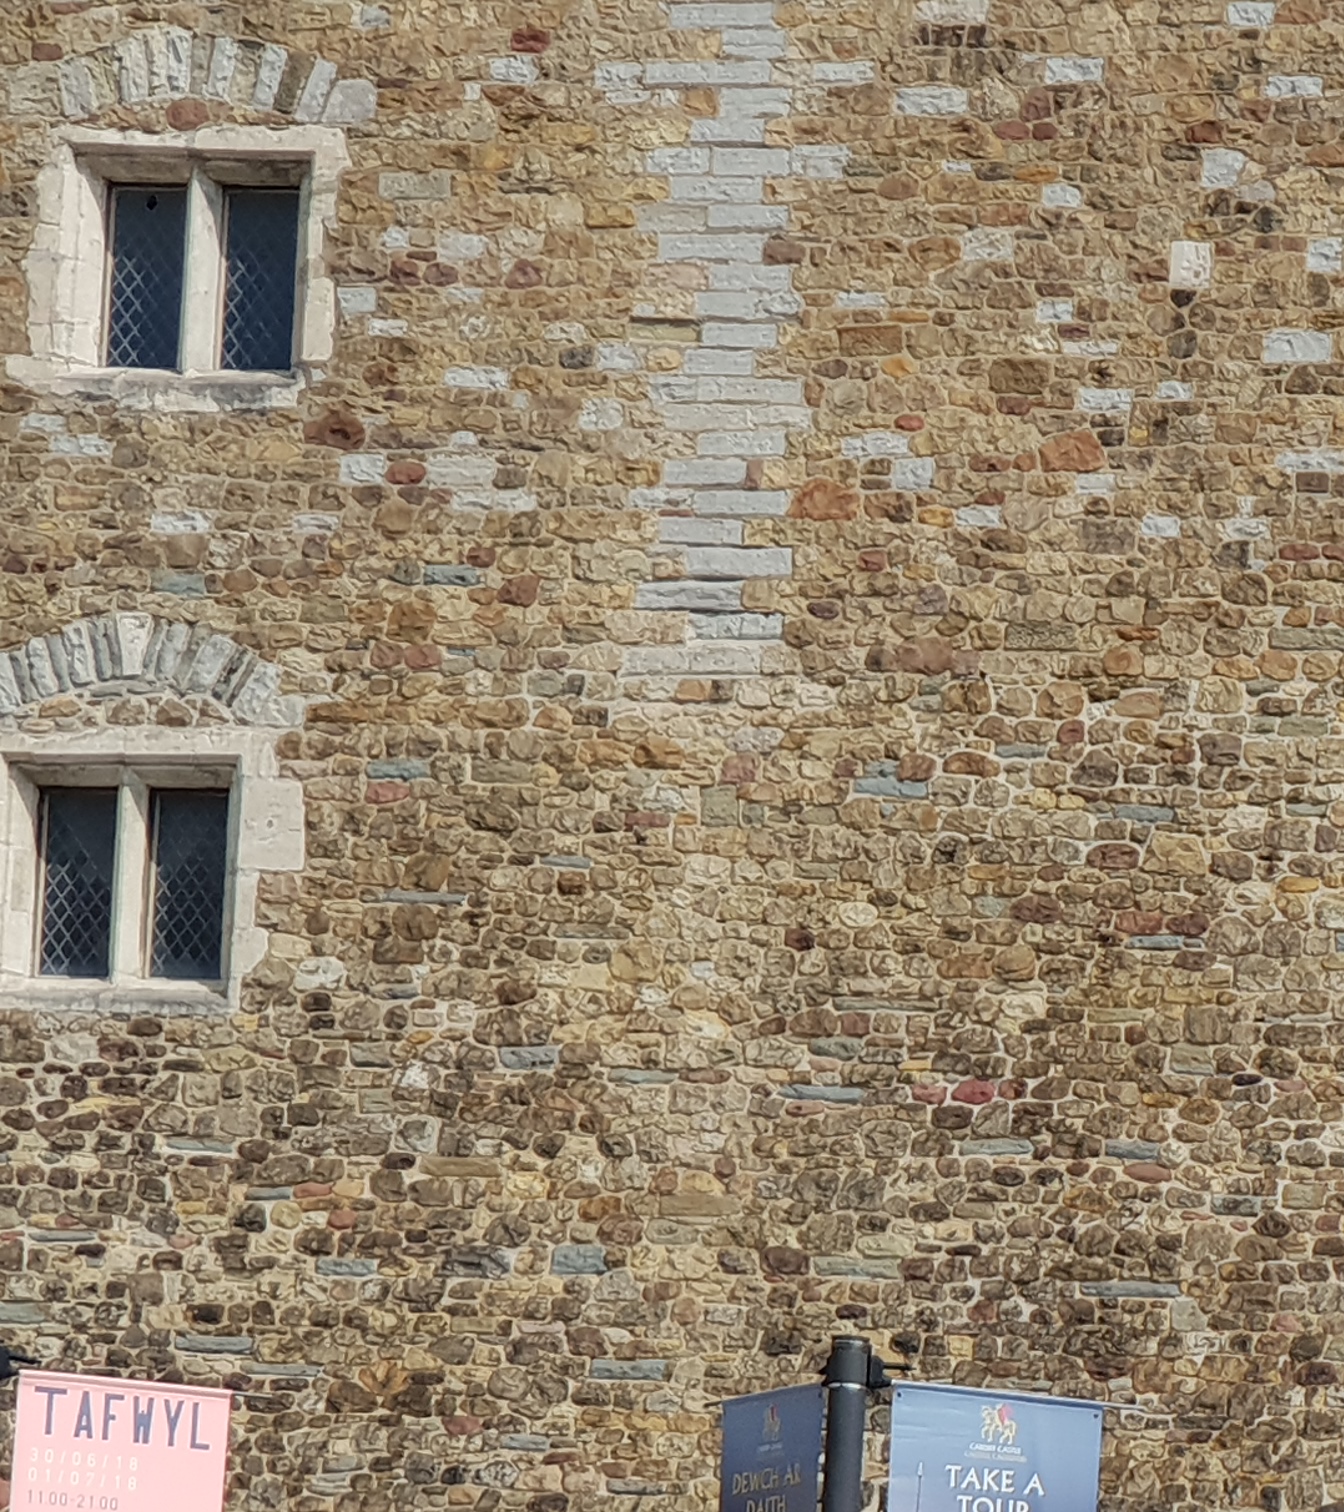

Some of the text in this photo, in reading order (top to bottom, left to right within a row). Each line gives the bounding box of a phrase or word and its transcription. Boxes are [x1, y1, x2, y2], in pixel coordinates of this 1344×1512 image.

[34, 1386, 210, 1450] TAFWYL
[30, 1448, 139, 1471] 30/06/18
[28, 1467, 138, 1490] 01/07/18
[732, 1467, 778, 1495] DEWCH
[945, 1464, 1044, 1496] TAKE A
